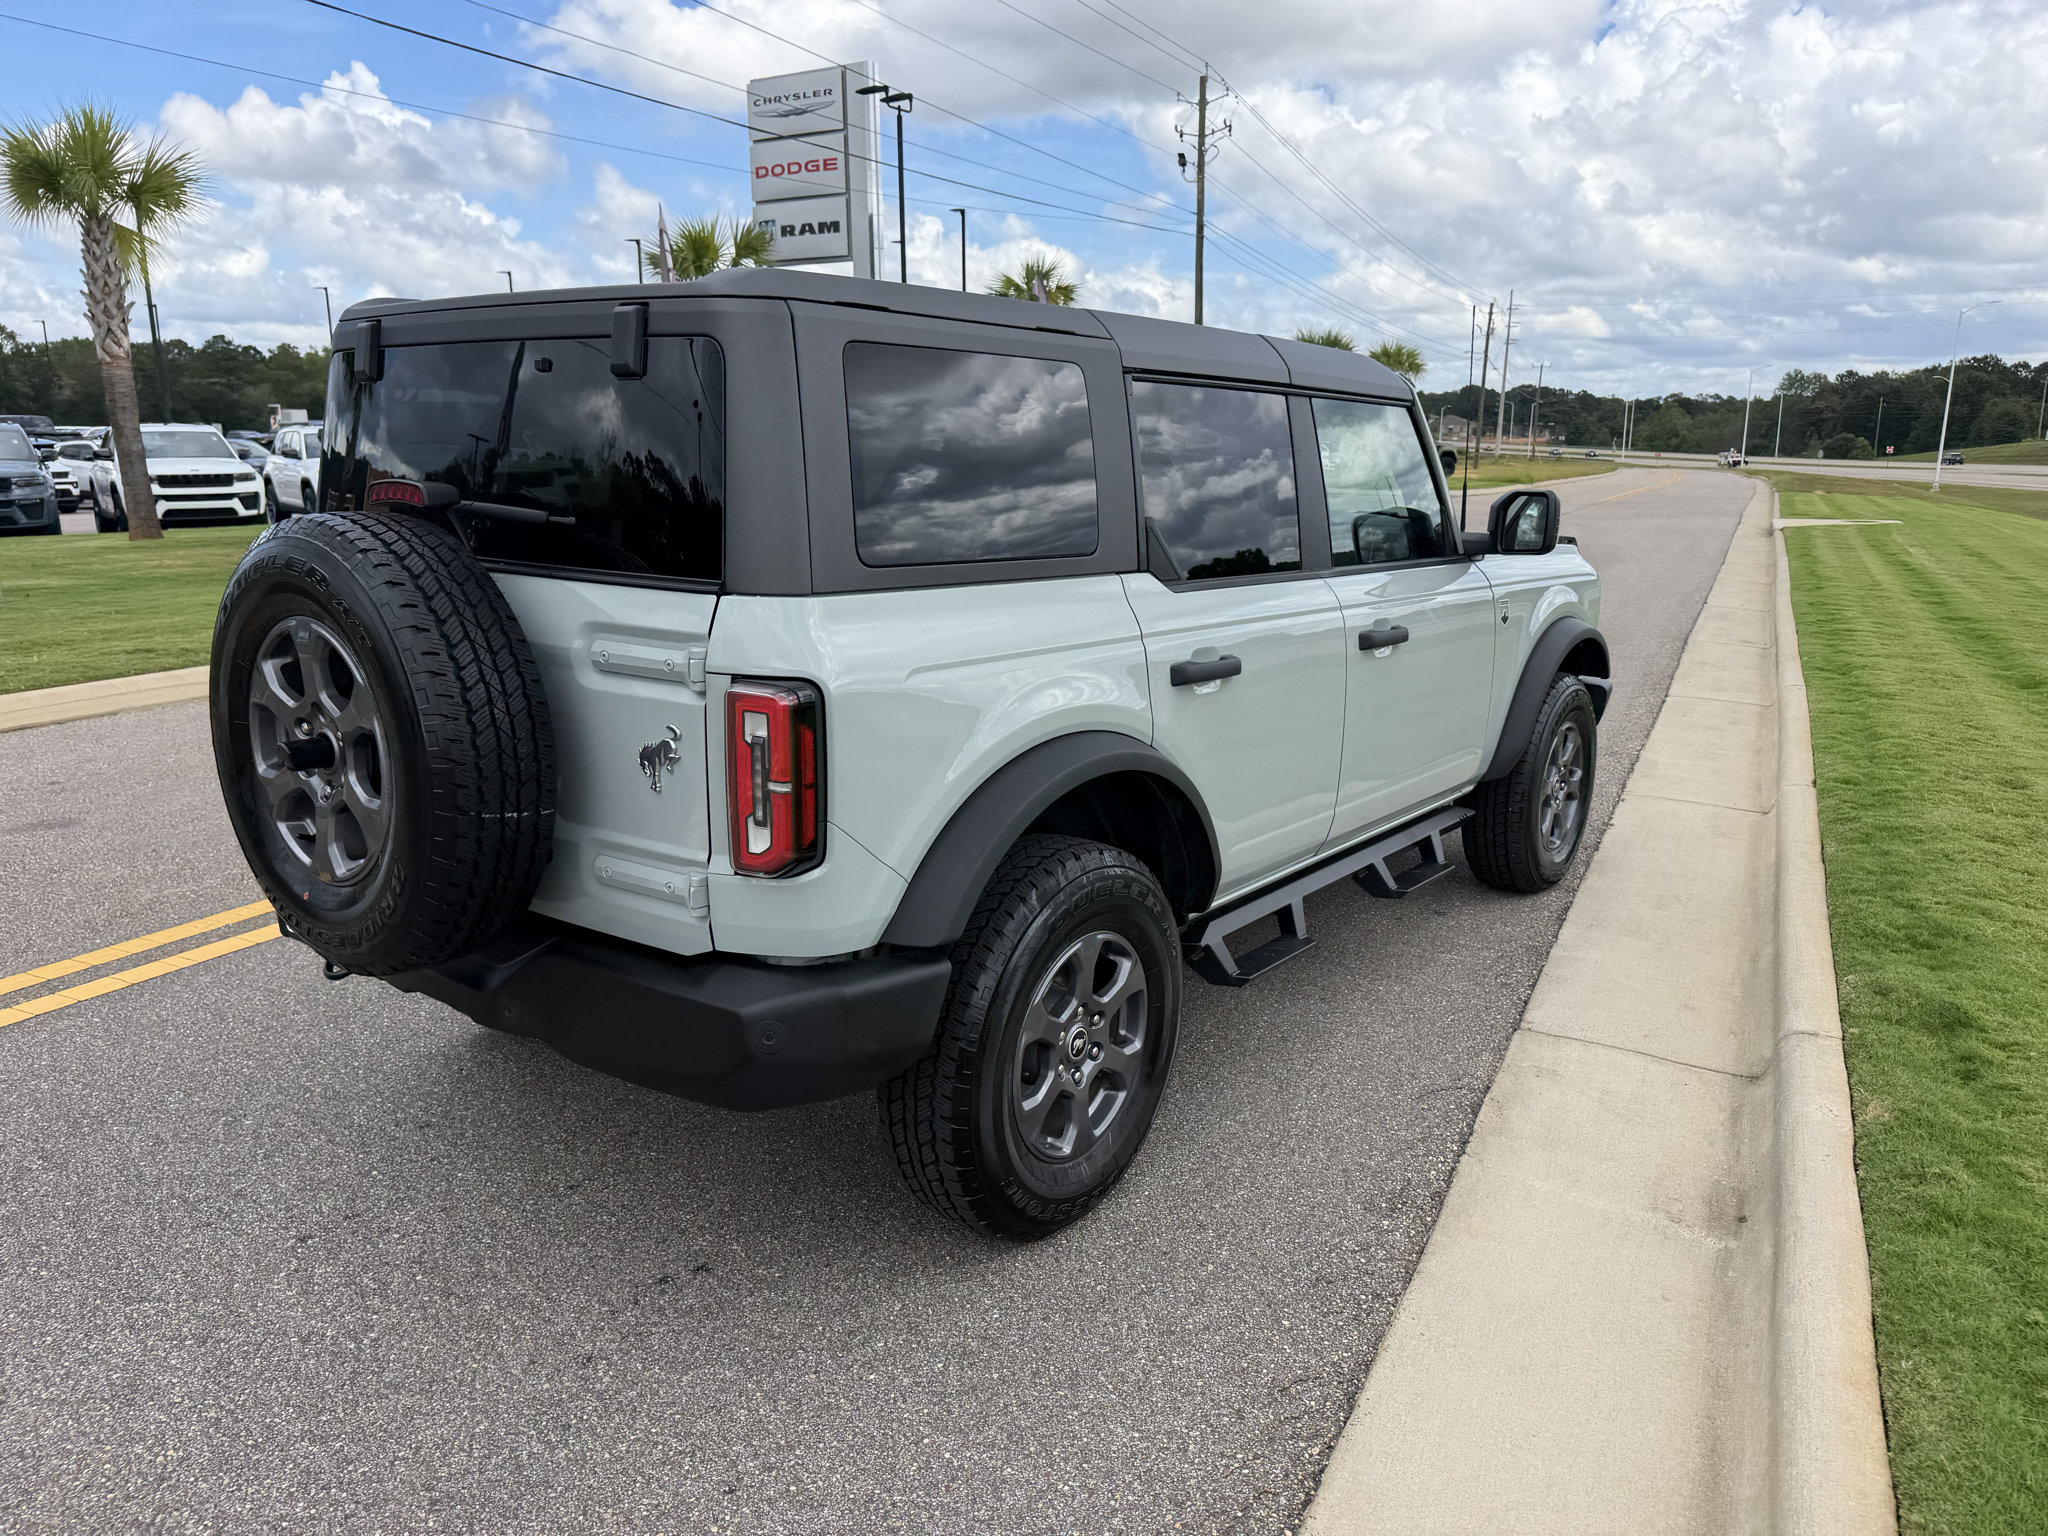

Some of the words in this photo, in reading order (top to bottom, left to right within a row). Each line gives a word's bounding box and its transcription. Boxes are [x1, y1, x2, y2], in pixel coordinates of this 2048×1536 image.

[753, 88, 833, 107] CHRYSLER
[755, 157, 838, 180] DODGE
[780, 220, 840, 238] RAM
